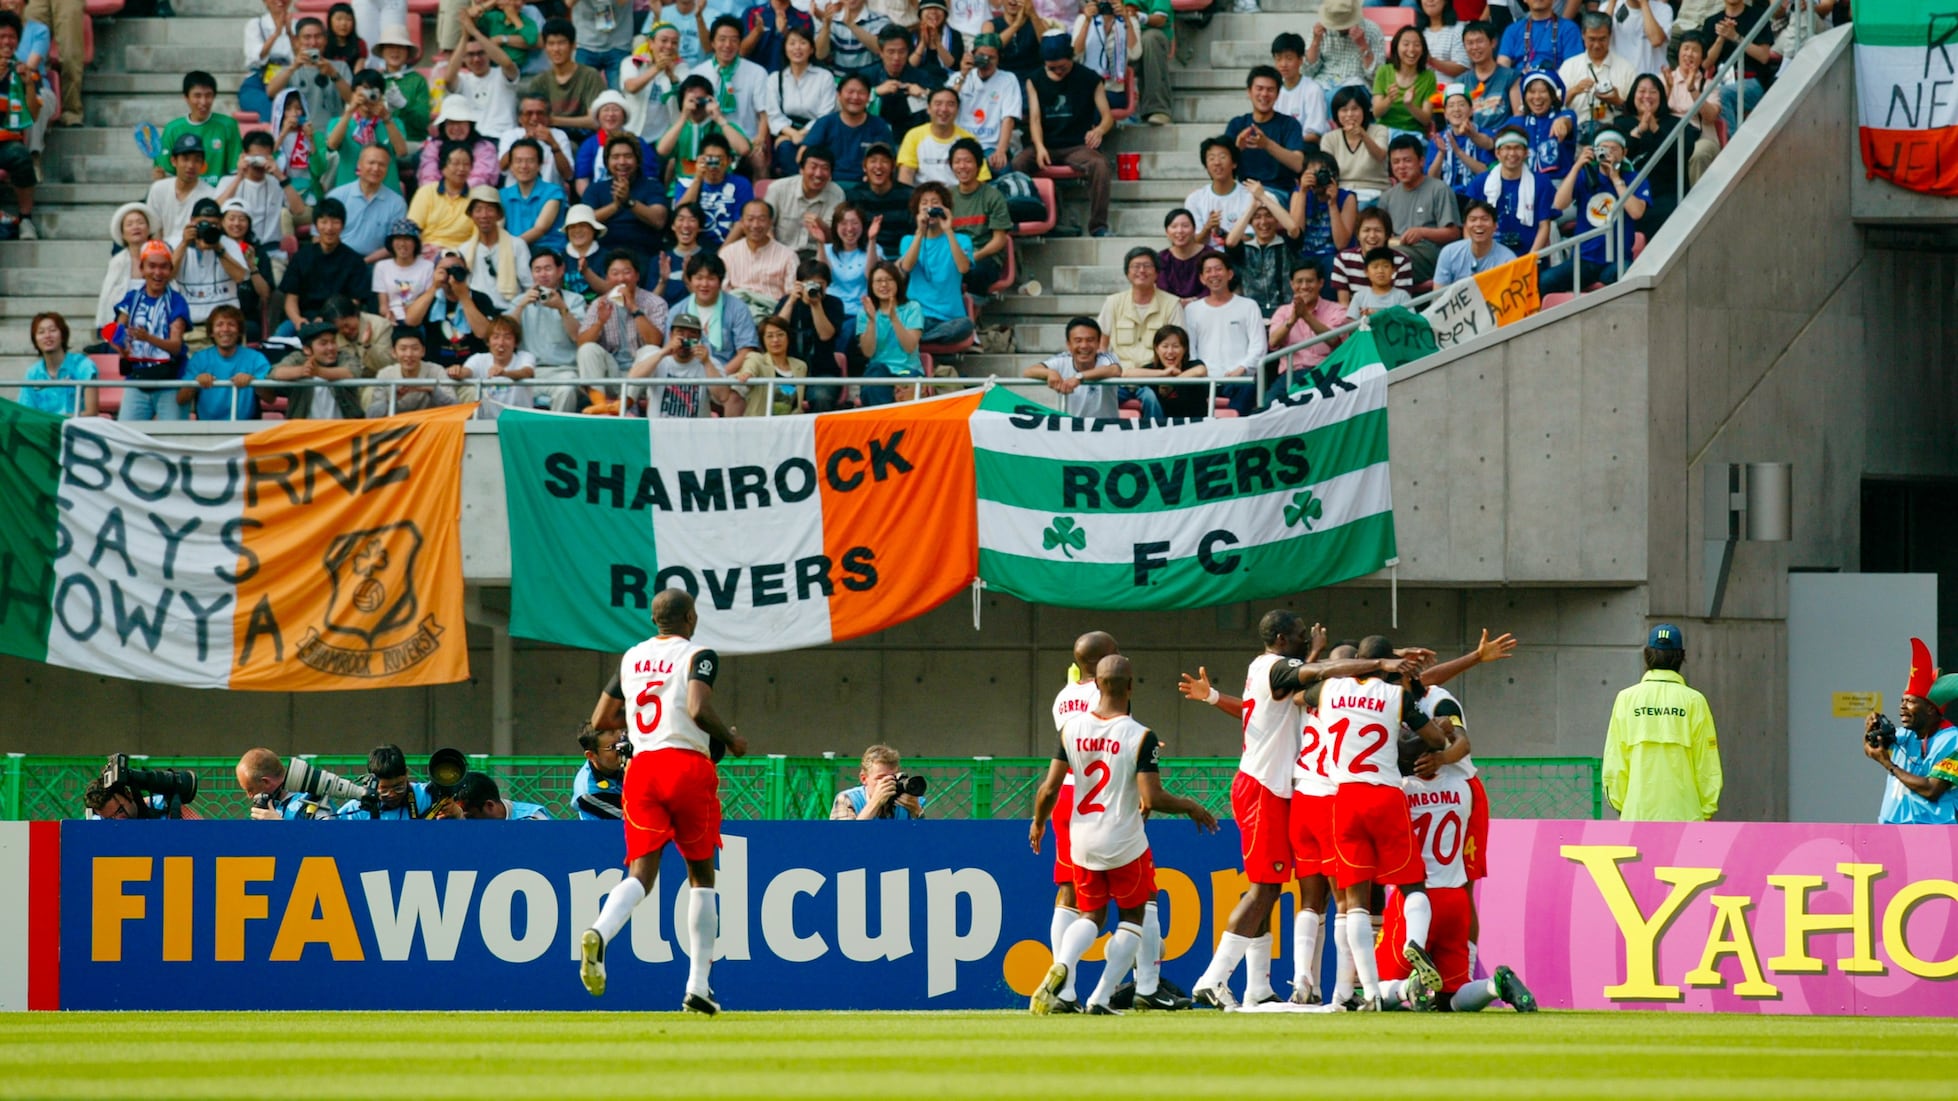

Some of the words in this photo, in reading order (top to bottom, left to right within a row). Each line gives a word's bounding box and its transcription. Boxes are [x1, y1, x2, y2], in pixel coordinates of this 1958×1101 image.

[1434, 287, 1472, 320] THE
[545, 429, 914, 512] SHAMROCK
[1063, 437, 1310, 509] ROVERS
[32, 493, 263, 584] SAYS
[610, 546, 878, 610] ROVERS
[0, 552, 284, 667] HOWYA
[383, 632, 433, 674] ROVERS
[636, 681, 664, 734] 5
[1331, 696, 1386, 713] LAUREN
[1633, 706, 1687, 717] STEWARD
[1328, 717, 1389, 774] 12
[1077, 760, 1111, 816] 2
[1407, 791, 1461, 808] MBOMA
[1412, 810, 1462, 866] 10
[1560, 845, 1958, 999] YAHO
